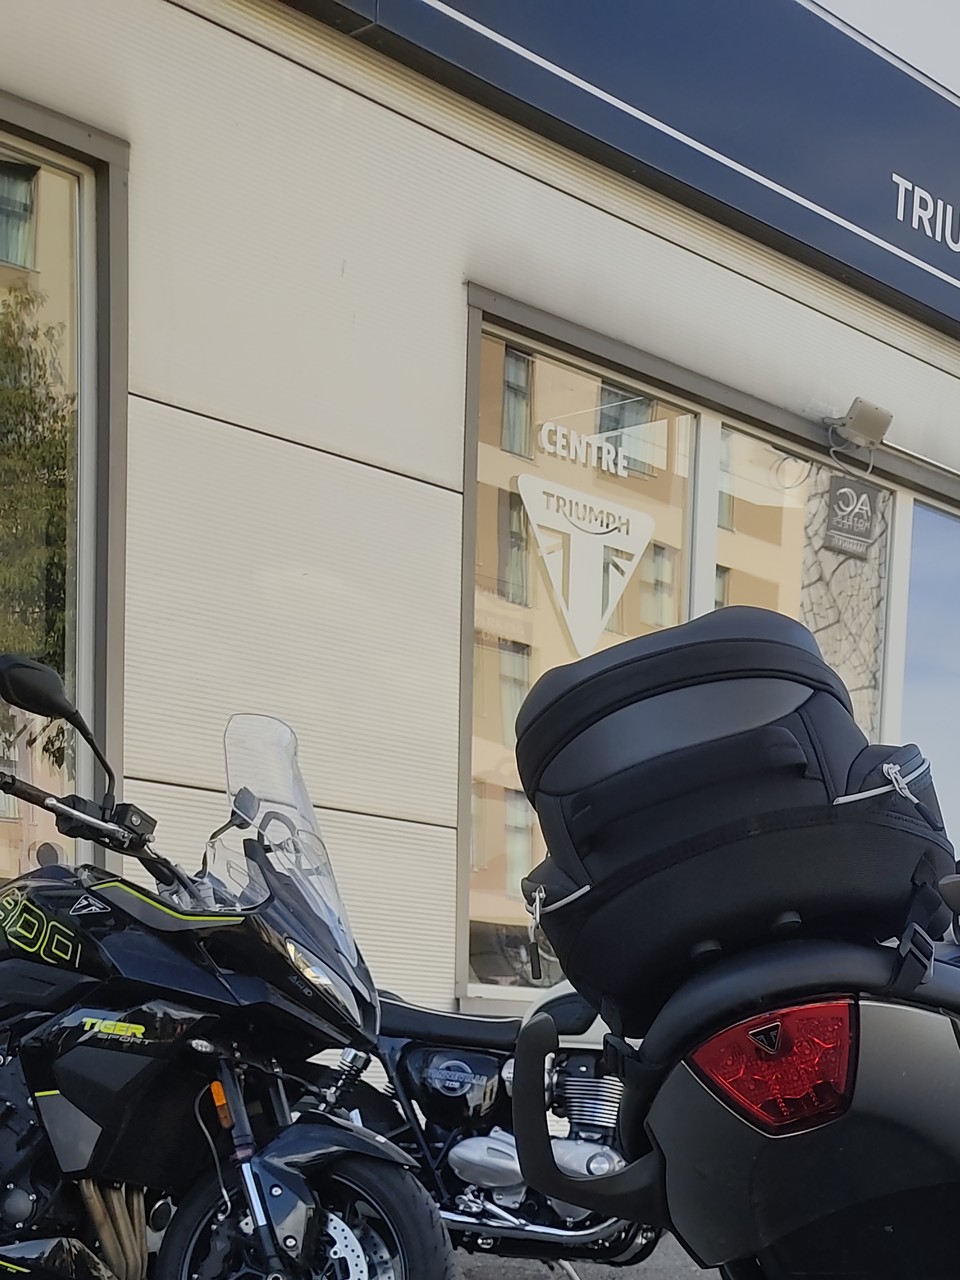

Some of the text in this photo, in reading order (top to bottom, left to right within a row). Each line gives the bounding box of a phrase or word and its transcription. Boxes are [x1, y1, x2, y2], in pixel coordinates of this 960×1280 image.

[541, 421, 629, 478] CENTRE
[542, 490, 630, 536] TRIUMPH
[78, 1017, 146, 1043] TIGER
[96, 1032, 155, 1046] SPORT
